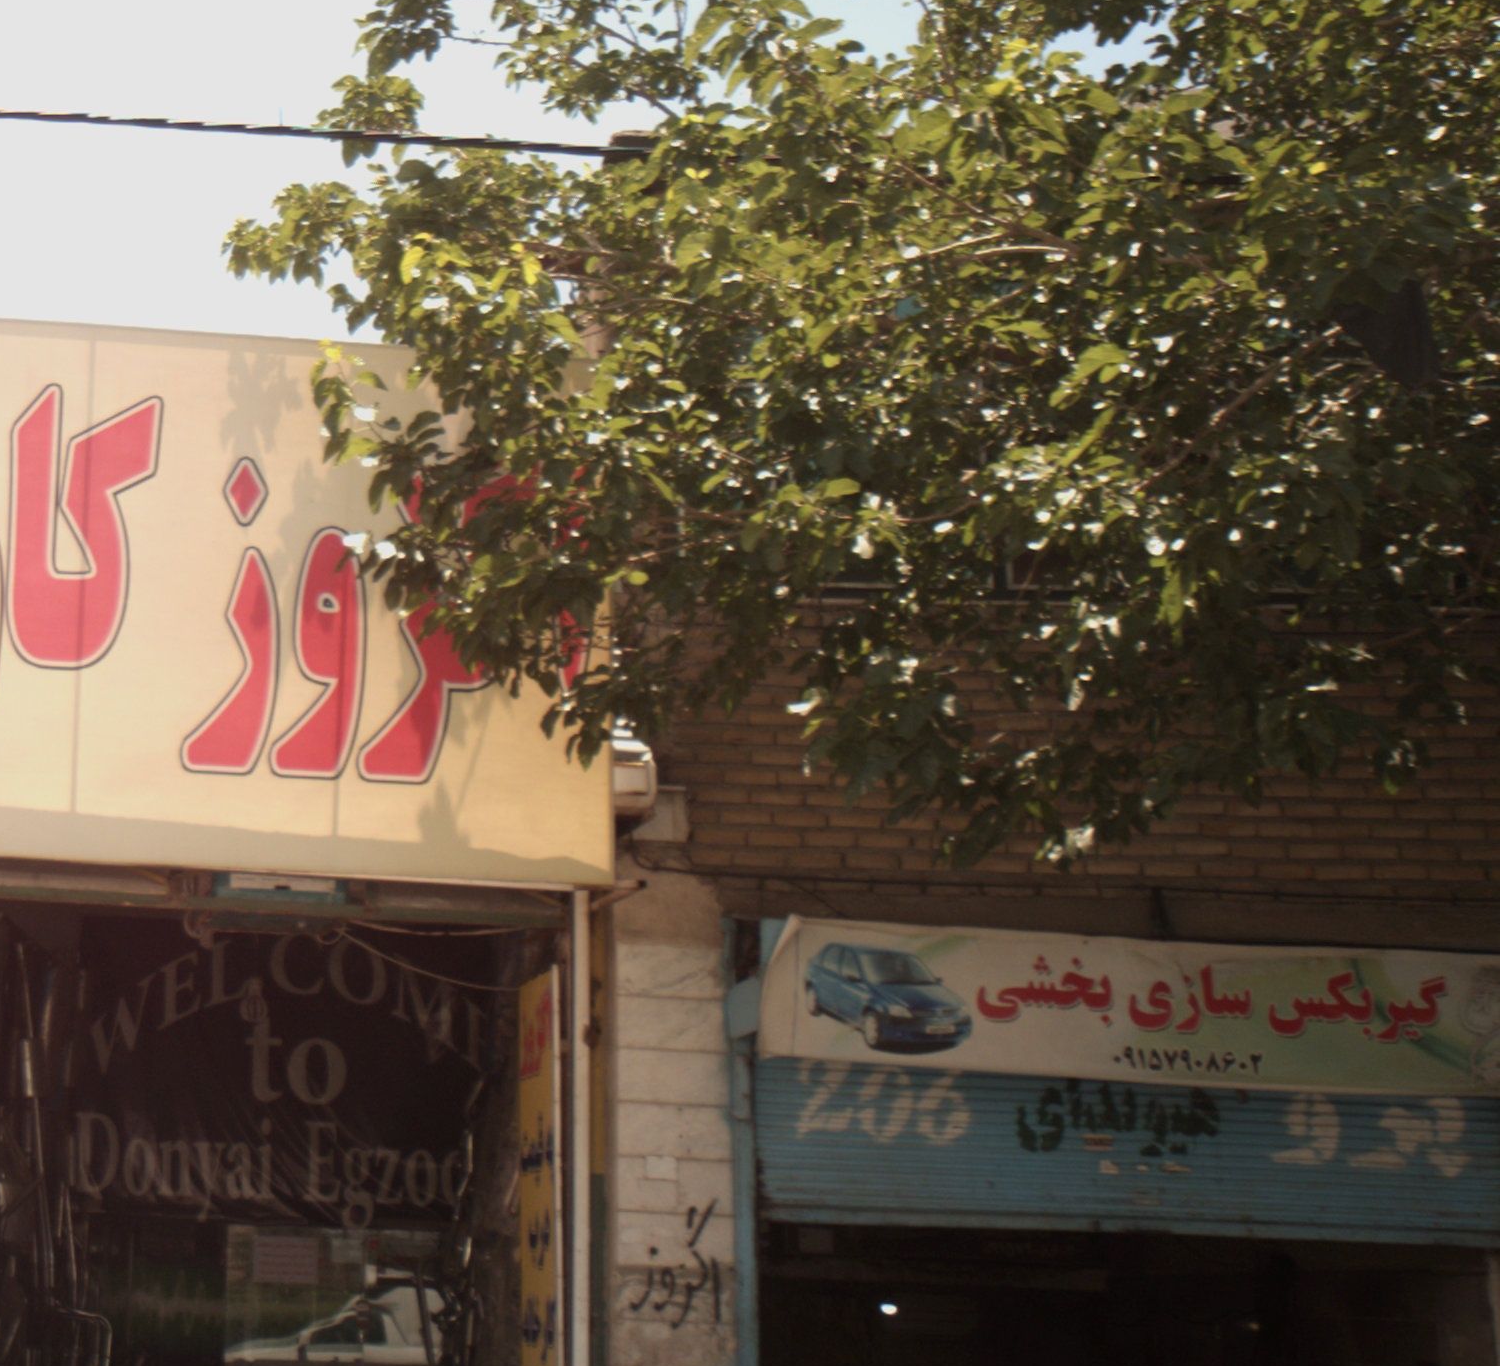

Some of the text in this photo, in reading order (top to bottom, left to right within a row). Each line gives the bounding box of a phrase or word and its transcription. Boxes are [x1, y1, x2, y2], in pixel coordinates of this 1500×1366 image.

[975, 954, 1448, 1042] گیربکس سازی بخشی
[245, 1018, 348, 1106] to
[76, 1111, 274, 1223] Donyai
